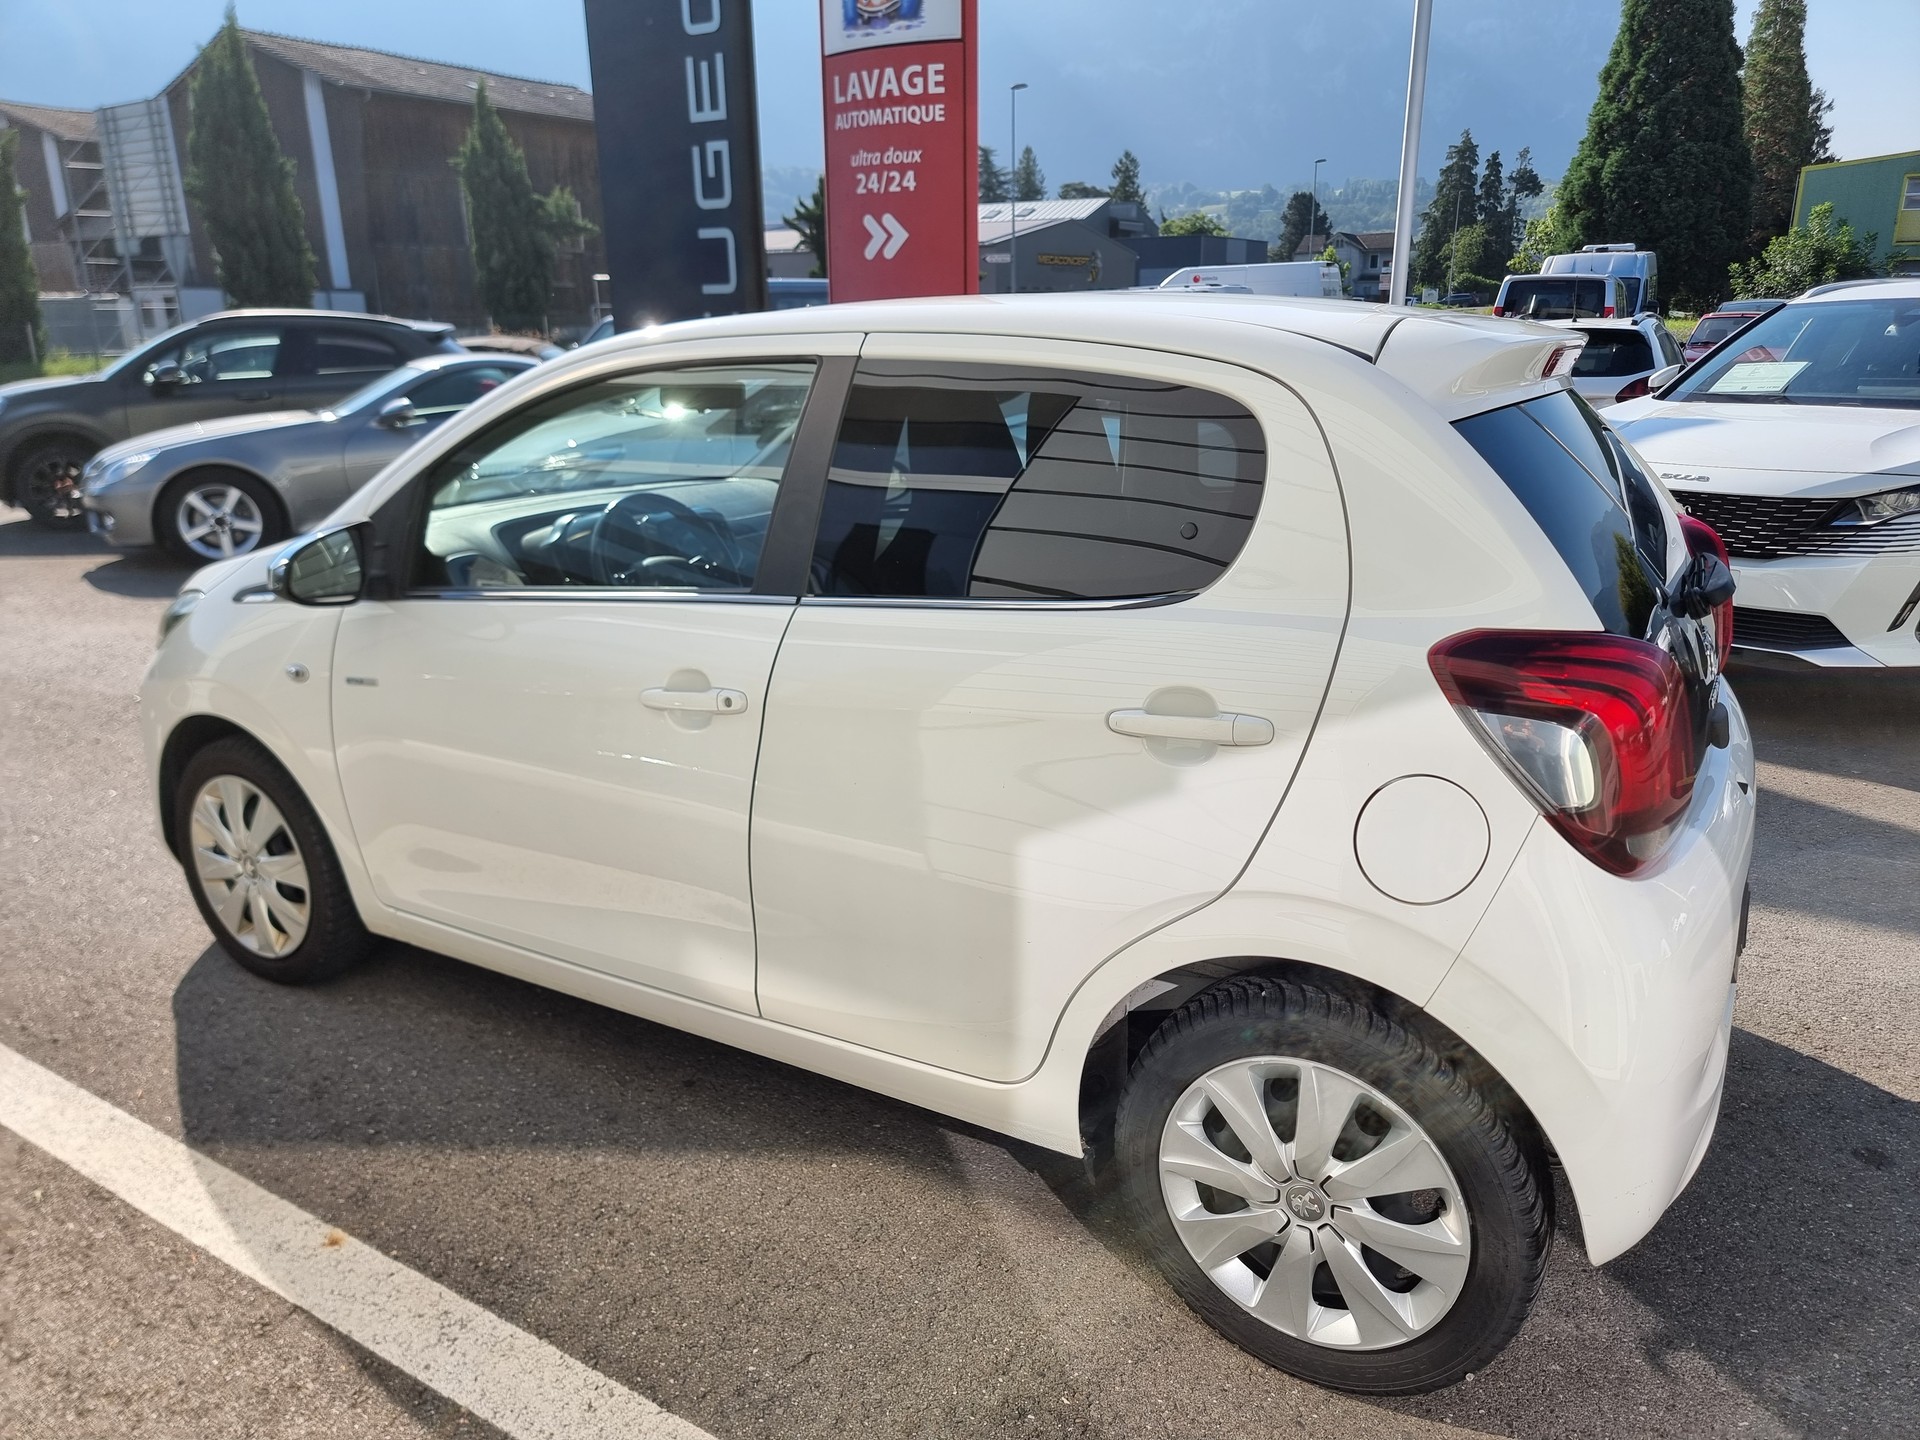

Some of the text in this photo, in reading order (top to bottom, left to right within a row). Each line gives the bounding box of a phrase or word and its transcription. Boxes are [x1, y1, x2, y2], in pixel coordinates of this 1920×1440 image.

[834, 63, 945, 104] LAVAGE
[834, 103, 946, 131] AUTOMATIQUE
[680, 0, 738, 318] UGE
[850, 146, 923, 168] ultra doux
[856, 170, 917, 195] 24/24
[1660, 472, 1710, 482] 5008
